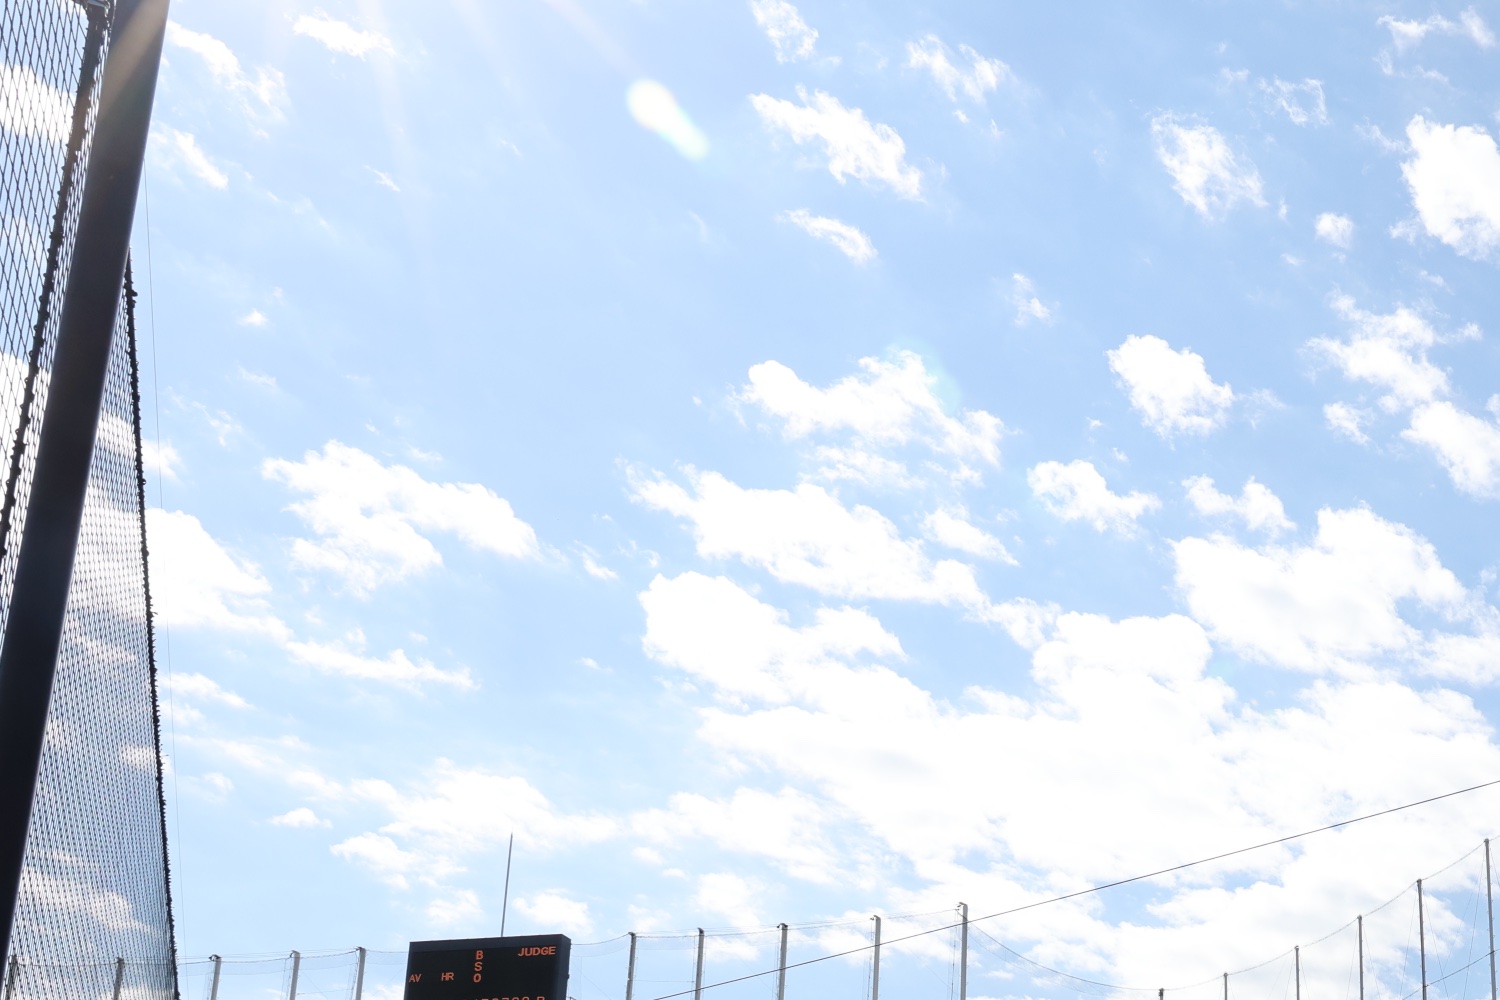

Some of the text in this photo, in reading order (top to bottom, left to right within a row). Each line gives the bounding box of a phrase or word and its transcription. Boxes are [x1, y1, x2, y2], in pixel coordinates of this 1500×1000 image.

[476, 950, 484, 960] B
[518, 946, 556, 957] JUDGE
[474, 962, 483, 971] S
[409, 974, 421, 983] AV
[441, 972, 454, 981] HR
